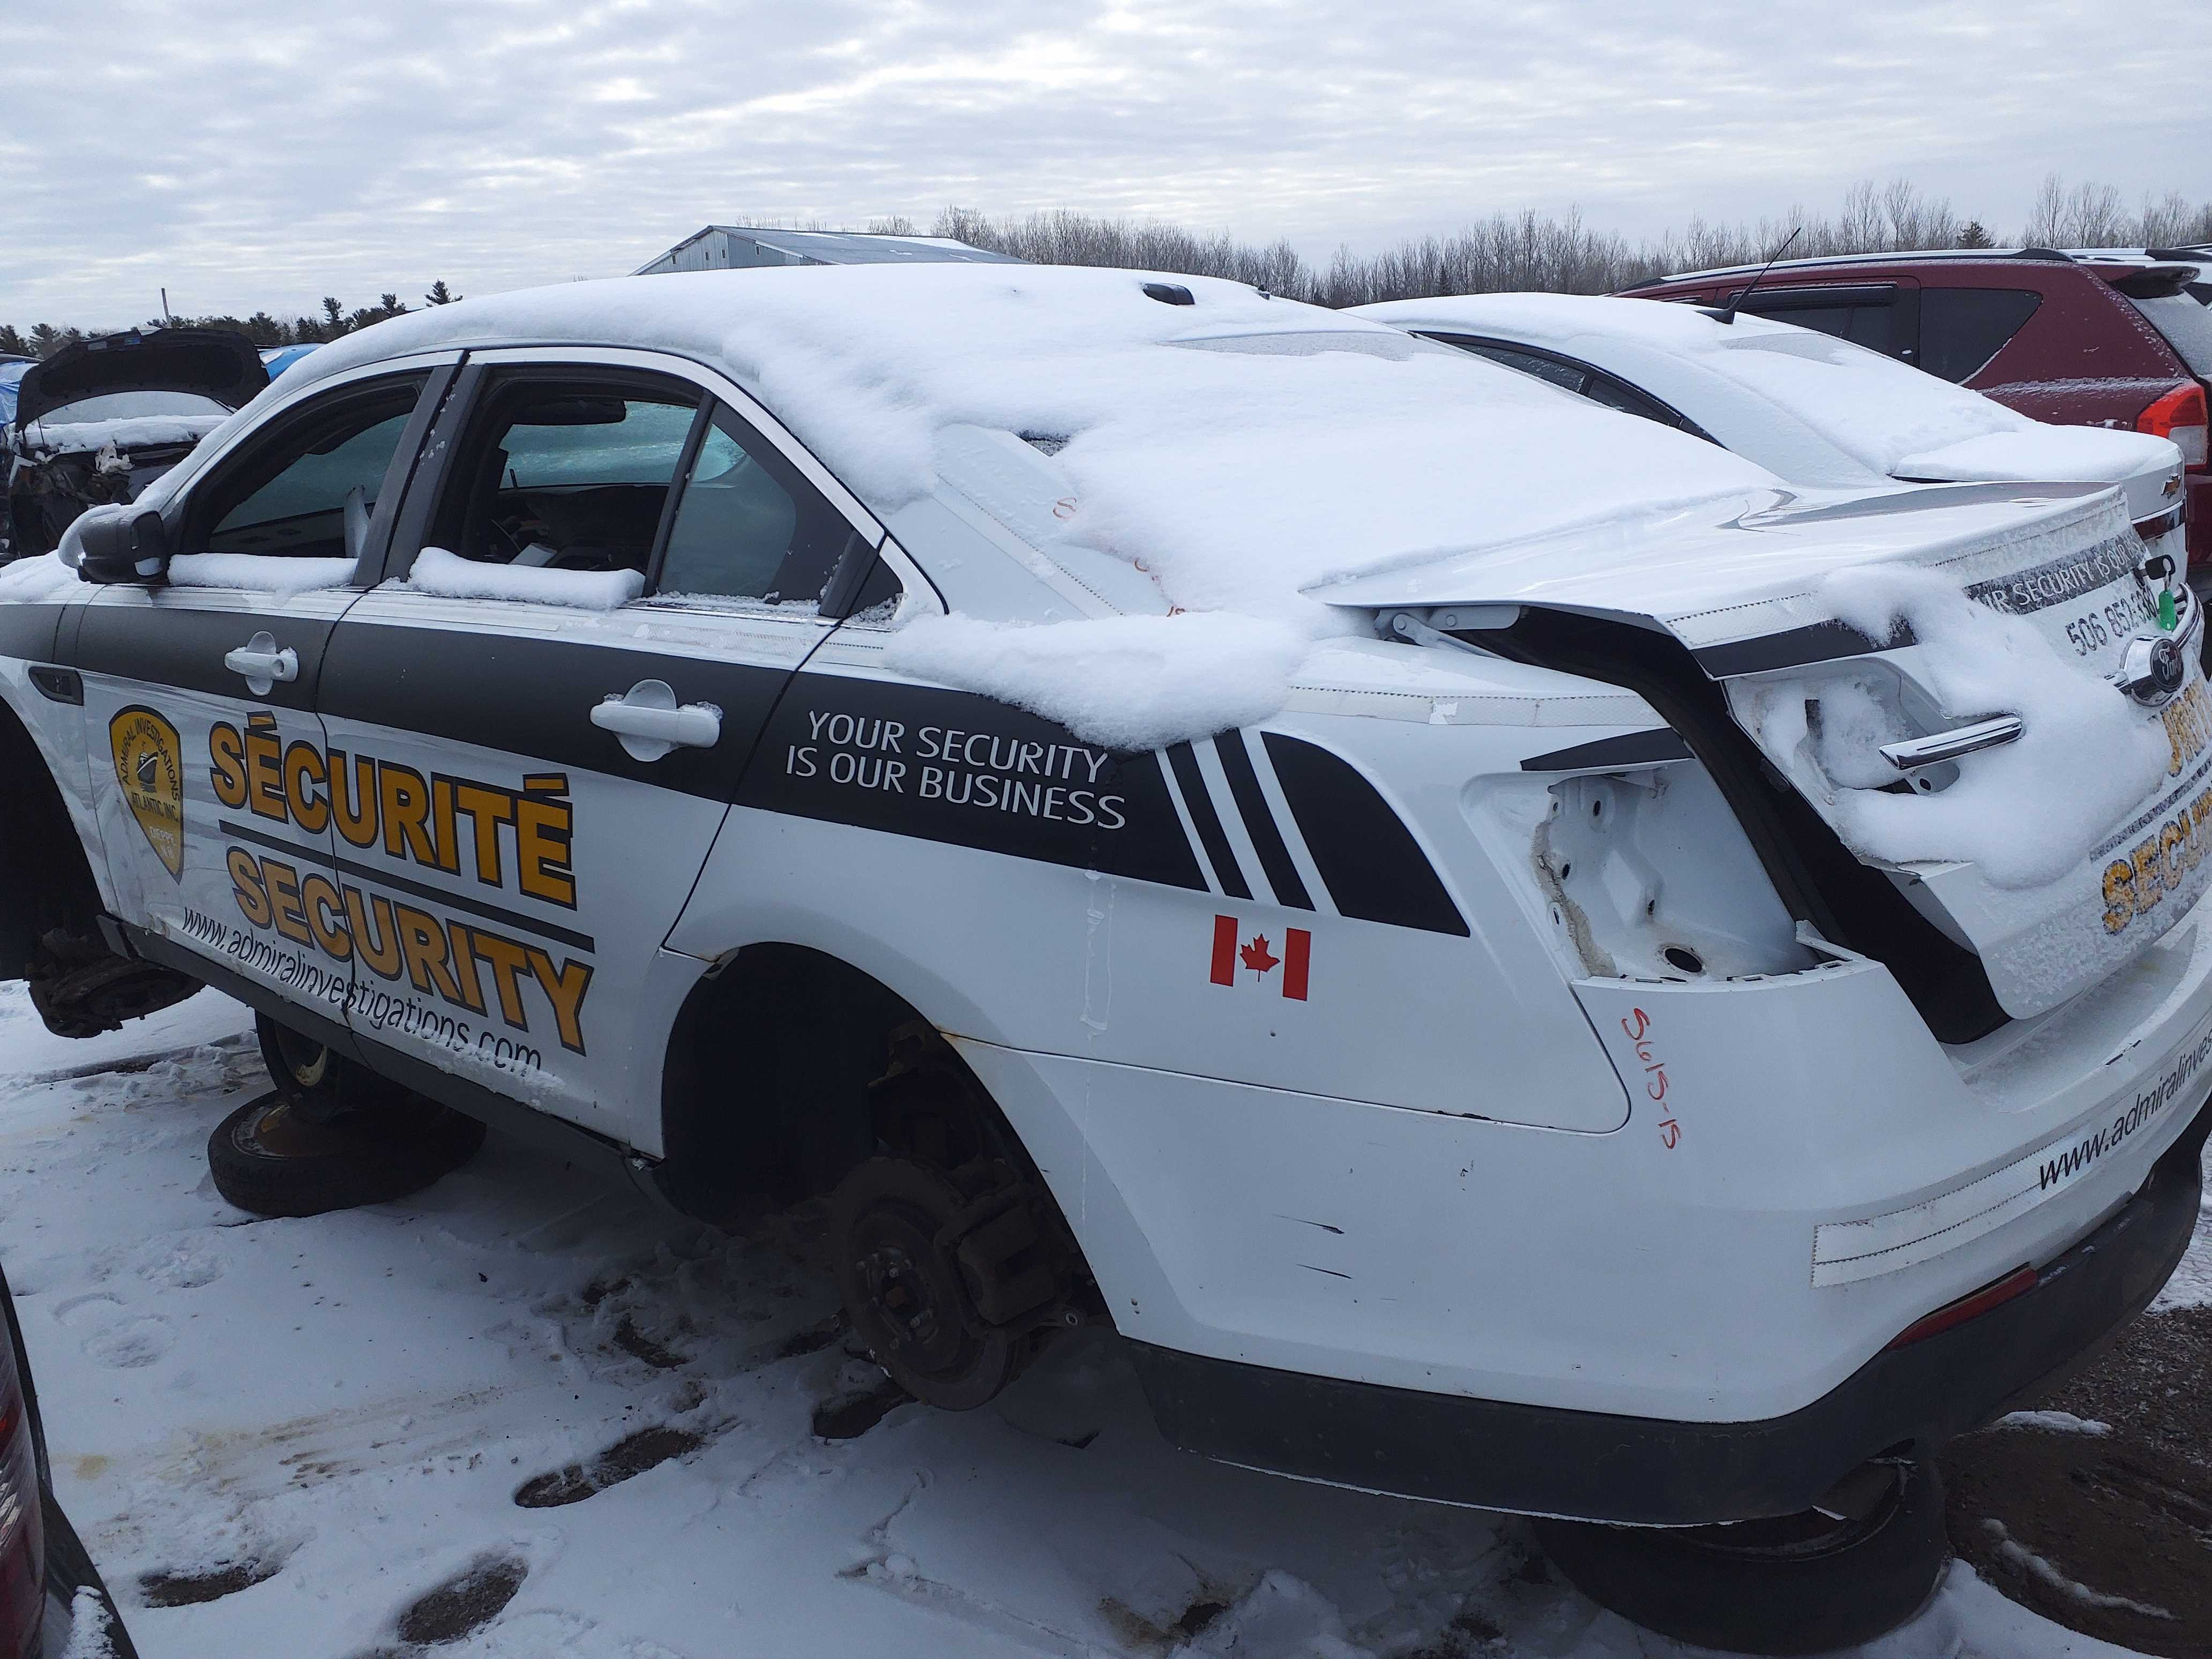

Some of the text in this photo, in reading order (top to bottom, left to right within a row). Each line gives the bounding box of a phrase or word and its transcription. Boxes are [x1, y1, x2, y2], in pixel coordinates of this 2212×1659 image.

[2012, 561, 2095, 606] SECURITY
[2093, 555, 2110, 578] IS
[2065, 612, 2108, 656] 506
[120, 724, 137, 786] ADMIRAL
[808, 709, 1109, 783] YOUR SECURITY
[208, 710, 578, 911] SÉCURITÉ
[786, 744, 1126, 830] IS OUR BUSINESS
[226, 845, 594, 1058] SECURITY
